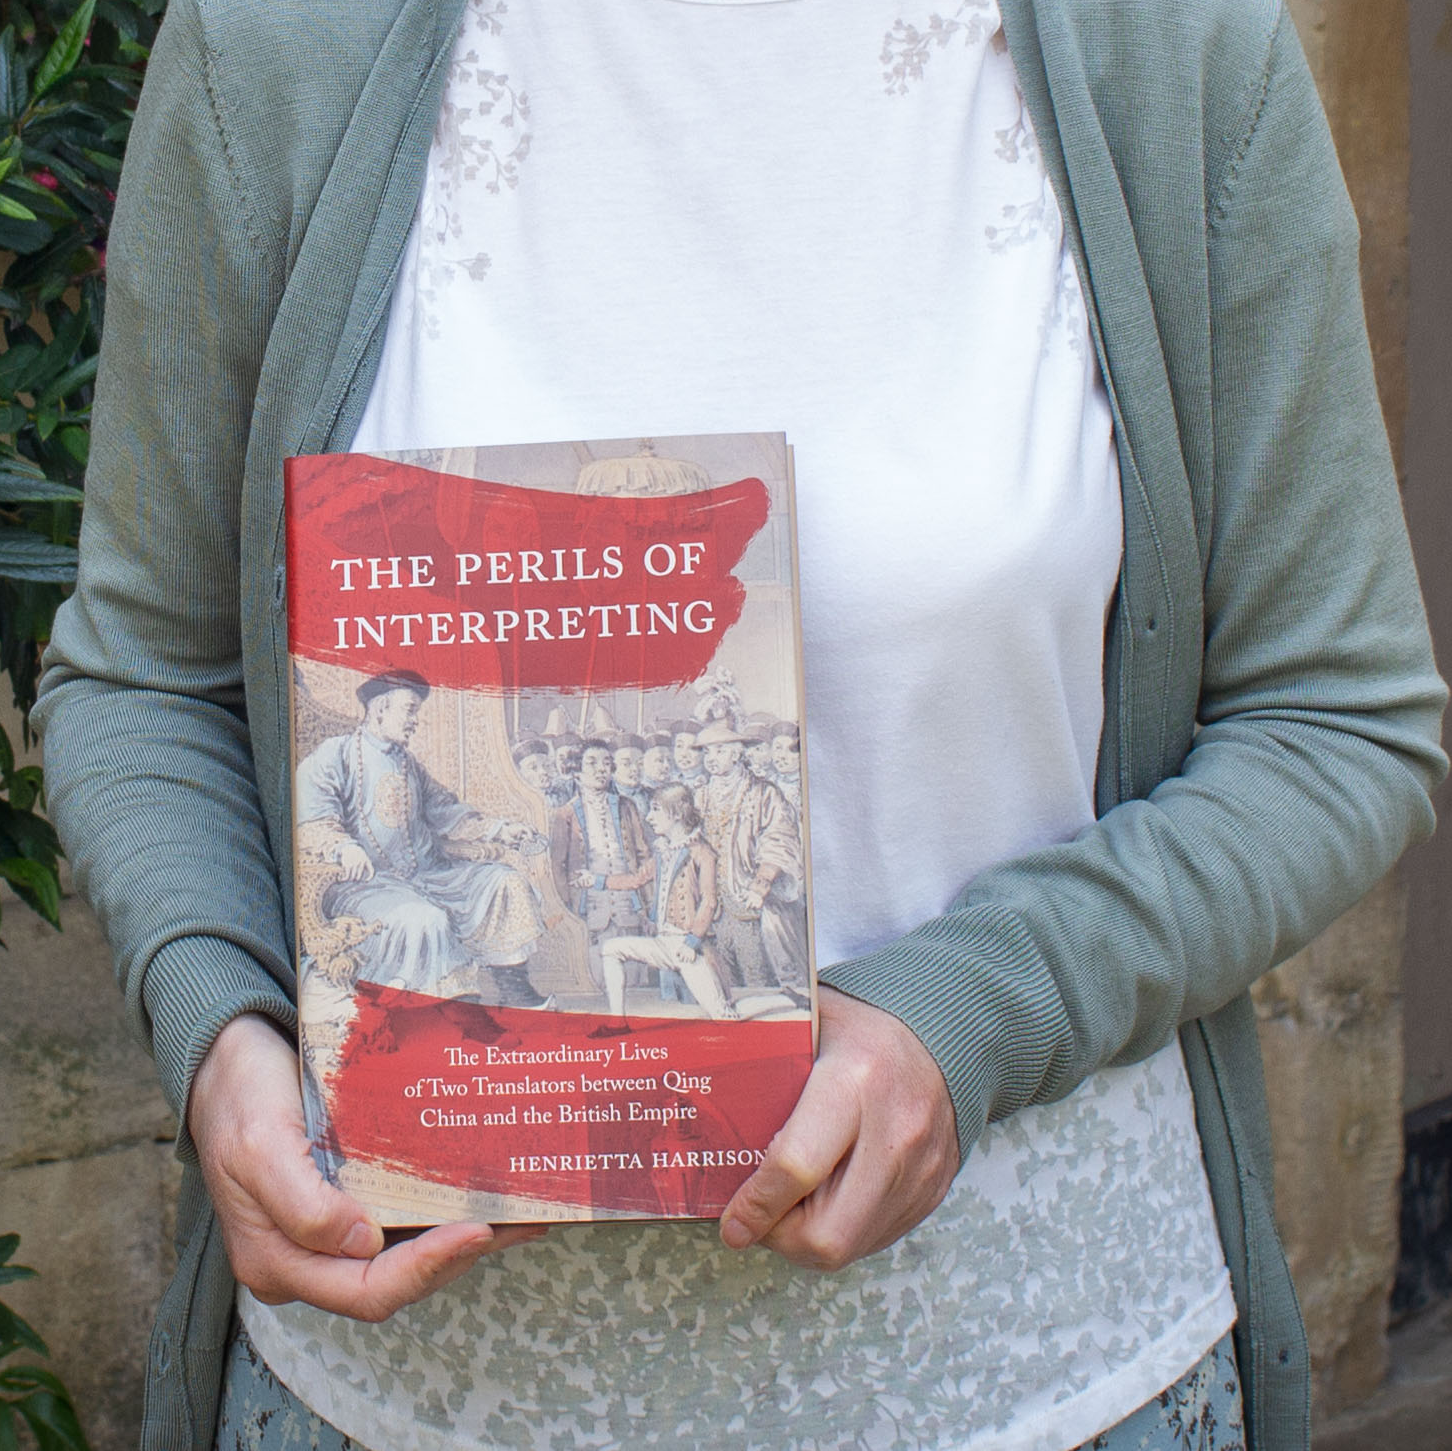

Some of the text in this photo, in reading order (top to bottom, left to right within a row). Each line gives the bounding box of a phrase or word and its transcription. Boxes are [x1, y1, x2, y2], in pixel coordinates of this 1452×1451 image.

[331, 542, 706, 591] THE PERILS OF
[333, 601, 717, 650] INTERPRETING
[444, 1041, 669, 1068] The Extraordinary Lives
[404, 1070, 712, 1098] of Two Translators between Qing
[420, 1102, 698, 1128] China and the British Empire
[509, 1153, 644, 1173] HENRIETTA
